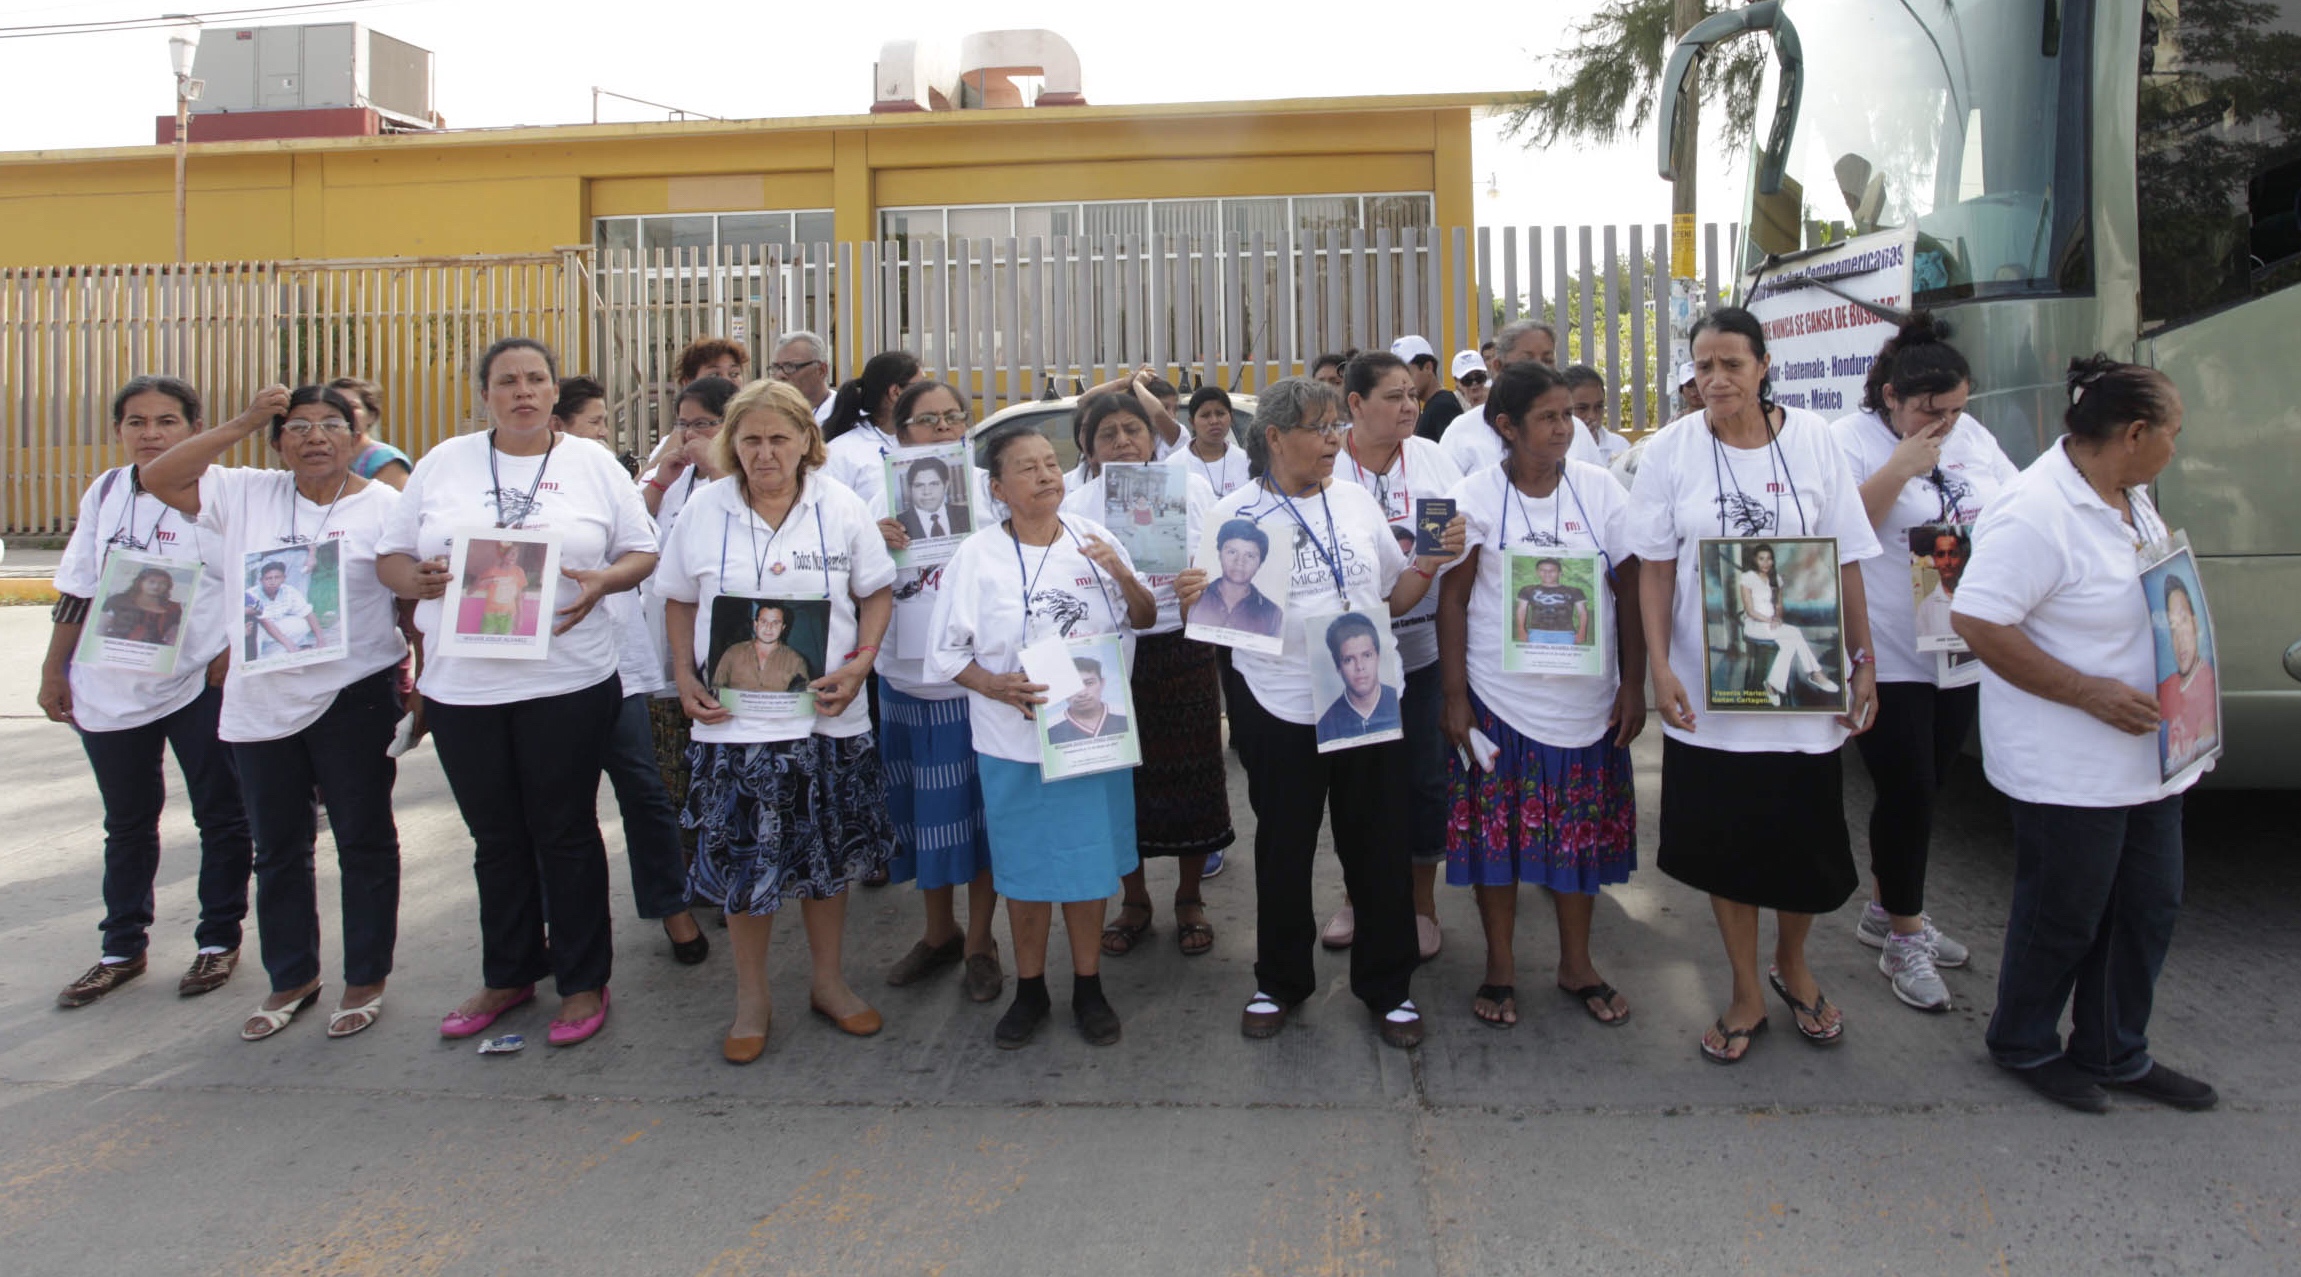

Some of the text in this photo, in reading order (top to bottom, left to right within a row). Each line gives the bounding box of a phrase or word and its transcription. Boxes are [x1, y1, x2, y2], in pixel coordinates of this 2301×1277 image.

[1772, 314, 1795, 340] NUNCA
[1795, 313, 1805, 337] SE
[1805, 307, 1834, 335] CANSA
[1835, 304, 1848, 330] DE
[1784, 357, 1825, 382] Guatemala
[1811, 388, 1843, 410] México
[1291, 560, 1372, 587] MIGRAIÓN
